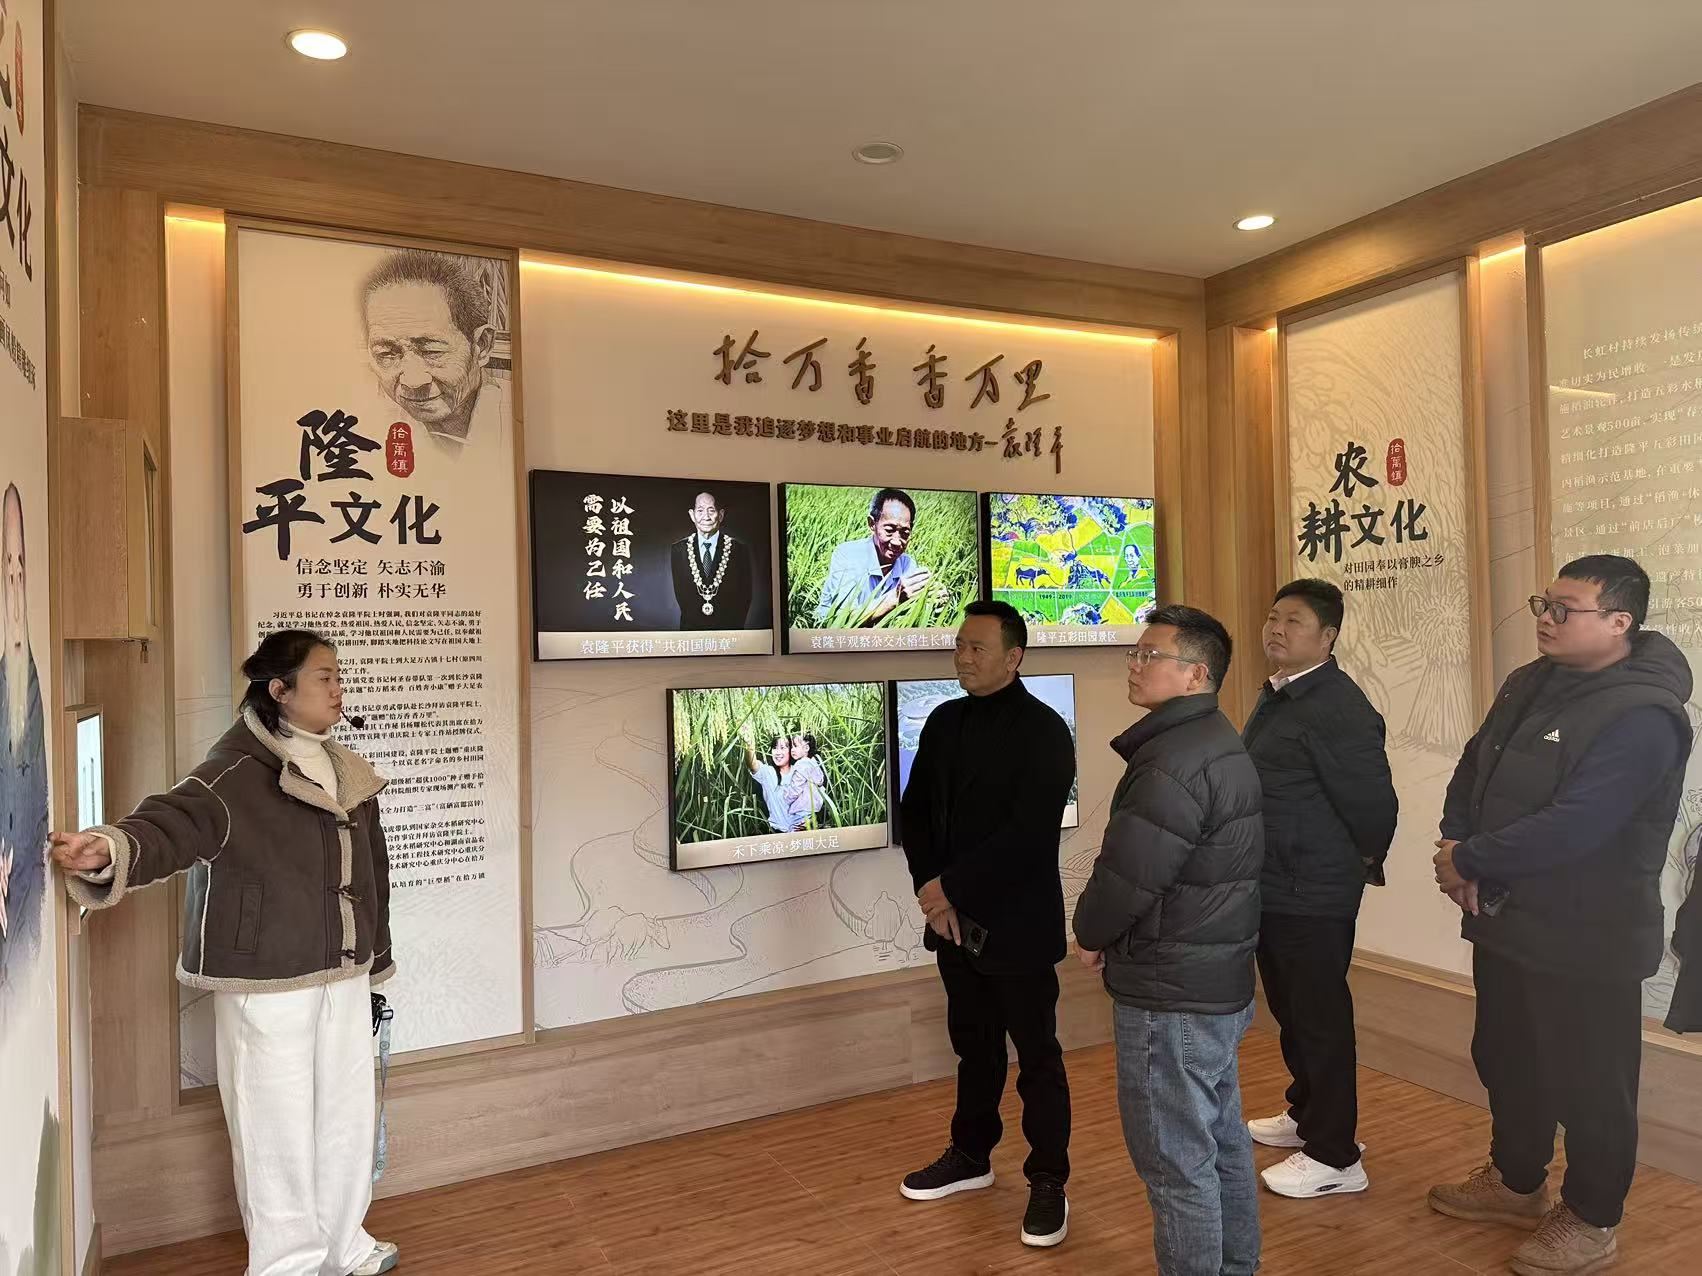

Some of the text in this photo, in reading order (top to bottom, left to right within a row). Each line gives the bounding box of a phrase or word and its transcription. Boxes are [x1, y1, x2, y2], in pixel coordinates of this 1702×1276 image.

[713, 329, 1051, 411] 拾万香 香万里
[581, 493, 608, 601] 需要为己任
[295, 558, 446, 576] 信念坚定 矢志不渝
[610, 495, 636, 622] 以祖国和人民
[296, 582, 447, 600] 勇于创新 朴实无华
[1343, 576, 1398, 592] 的精耕细作
[580, 637, 738, 655] 袁隆平获得“共和国勋章”
[1035, 631, 1118, 643] 隆平五彩田园景区
